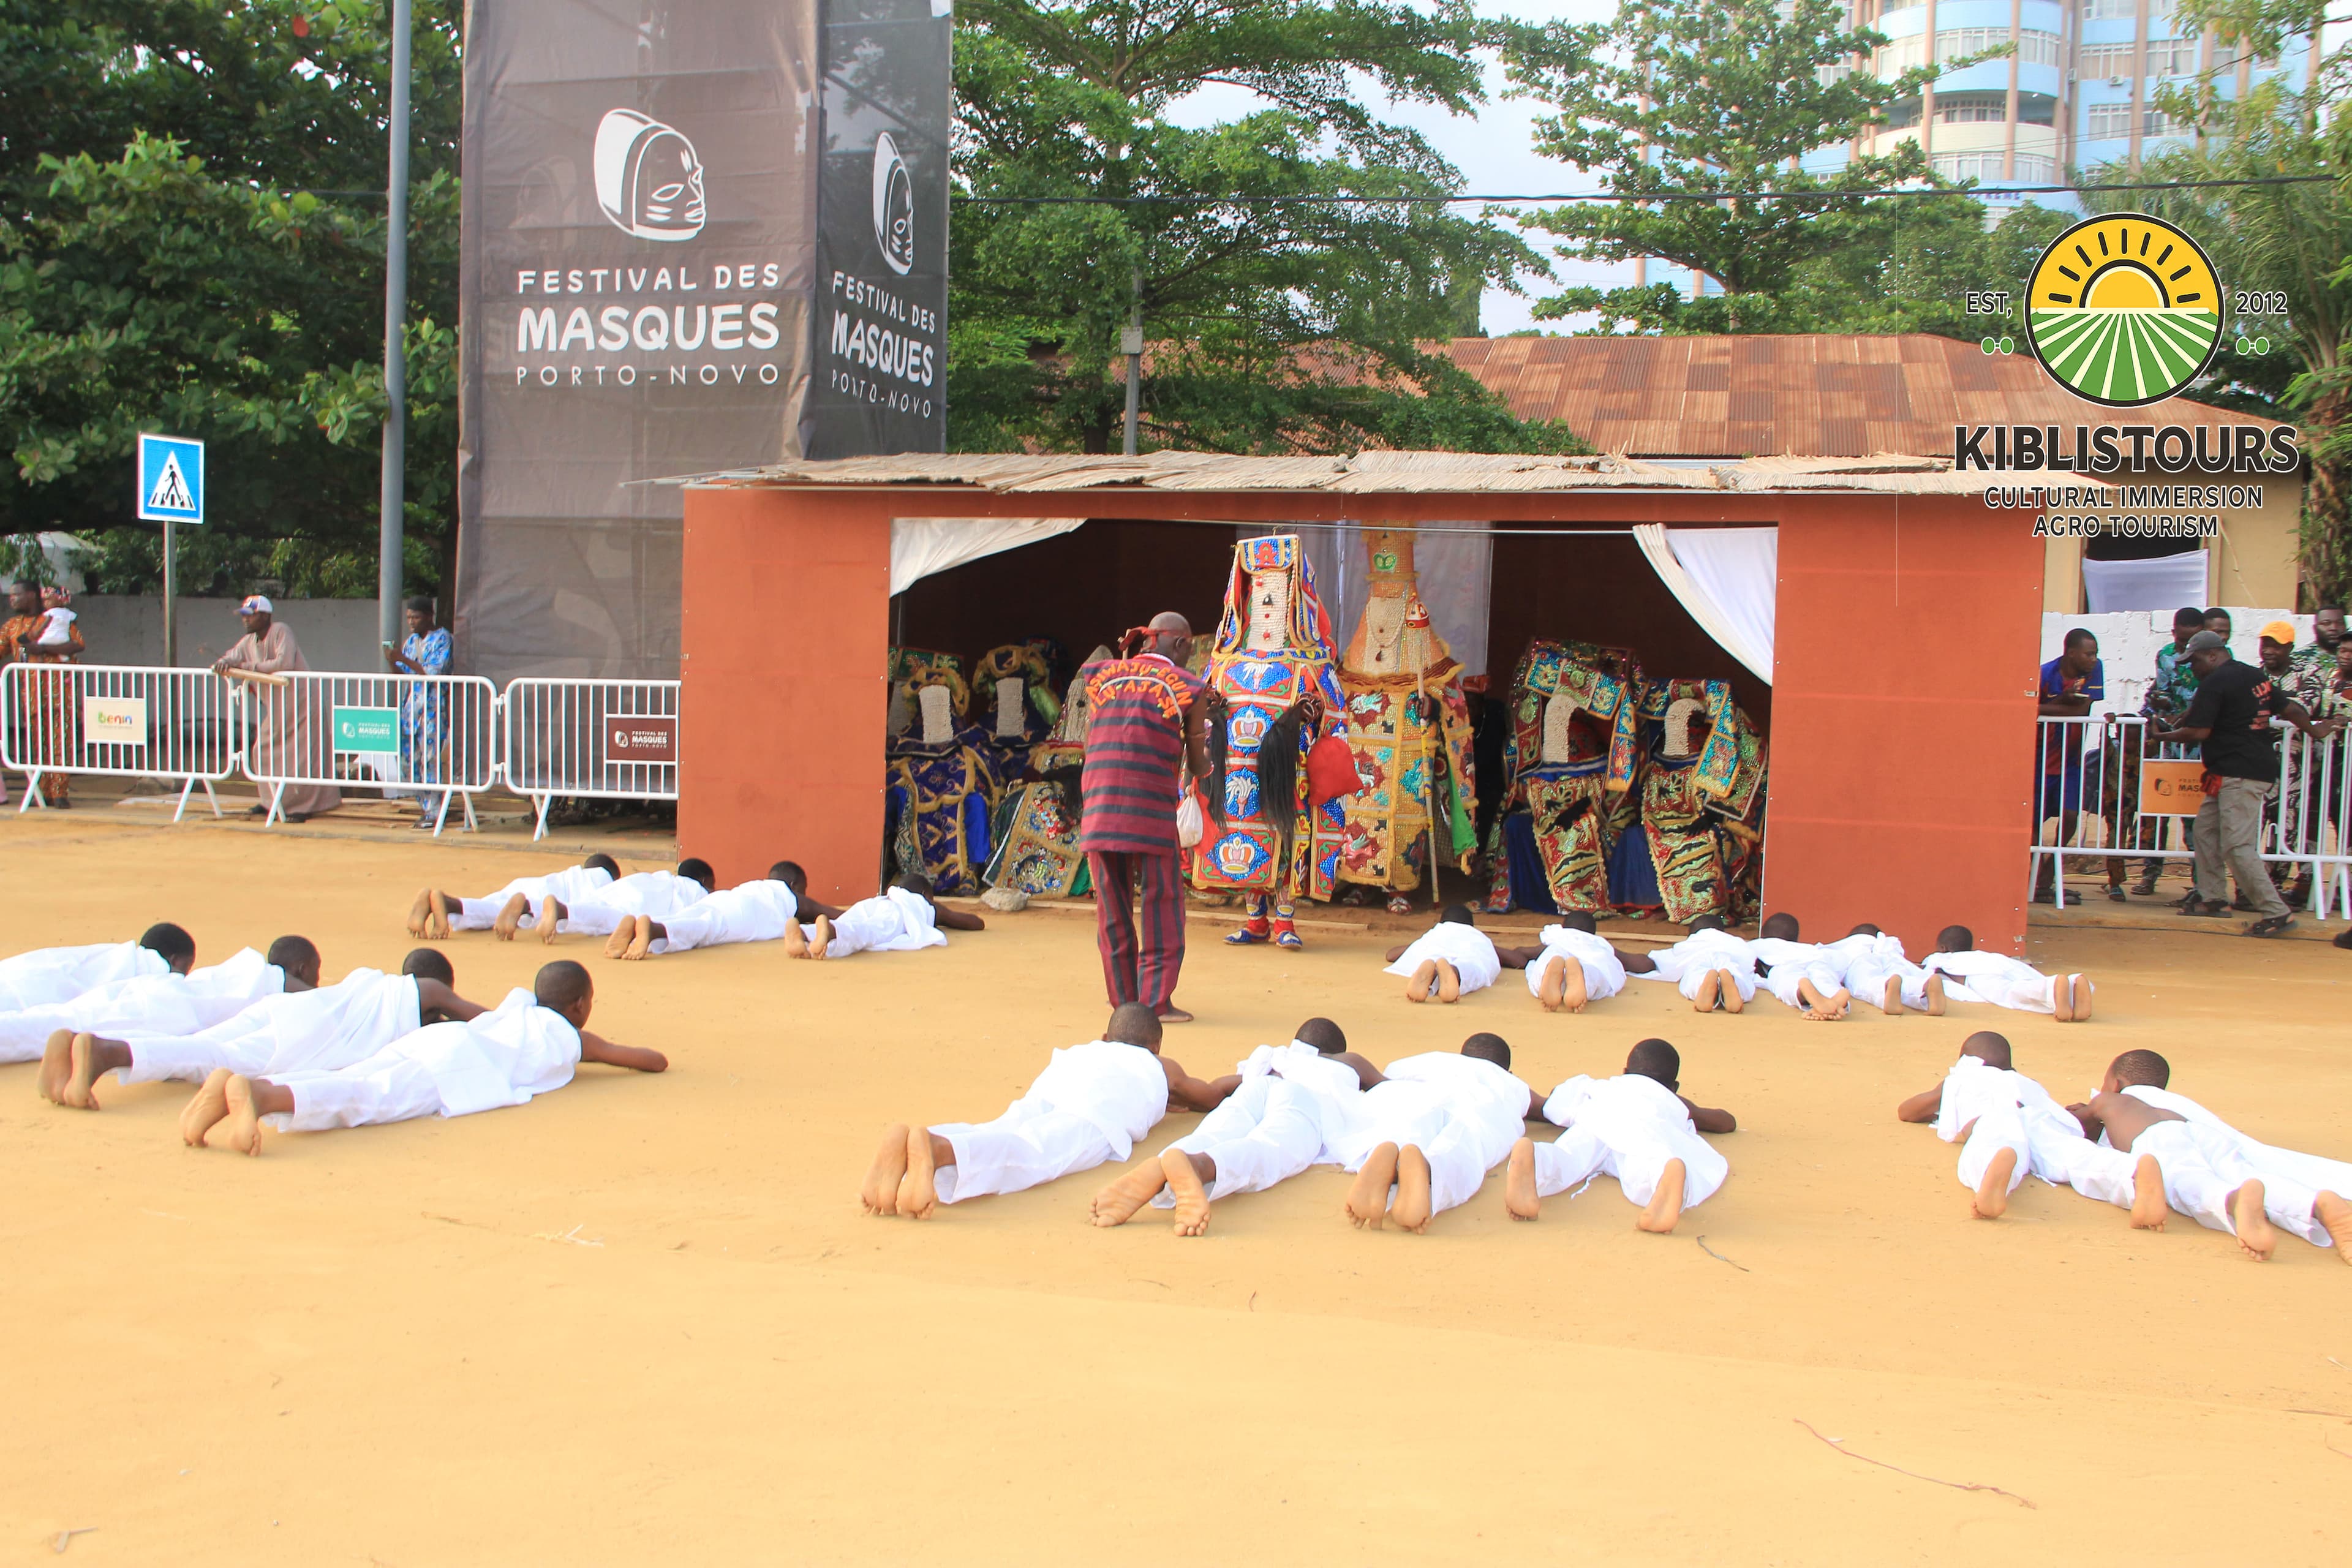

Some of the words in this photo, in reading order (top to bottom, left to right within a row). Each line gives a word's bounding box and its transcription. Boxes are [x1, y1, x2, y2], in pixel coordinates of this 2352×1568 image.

[518, 267, 697, 294] FESTIVAL
[714, 263, 779, 290] DES
[832, 271, 906, 323] FESTIVAL
[911, 304, 935, 333] DES
[518, 302, 780, 352] MASQUES
[832, 309, 933, 386] MASQUES
[631, 736, 668, 744] MASQUES
